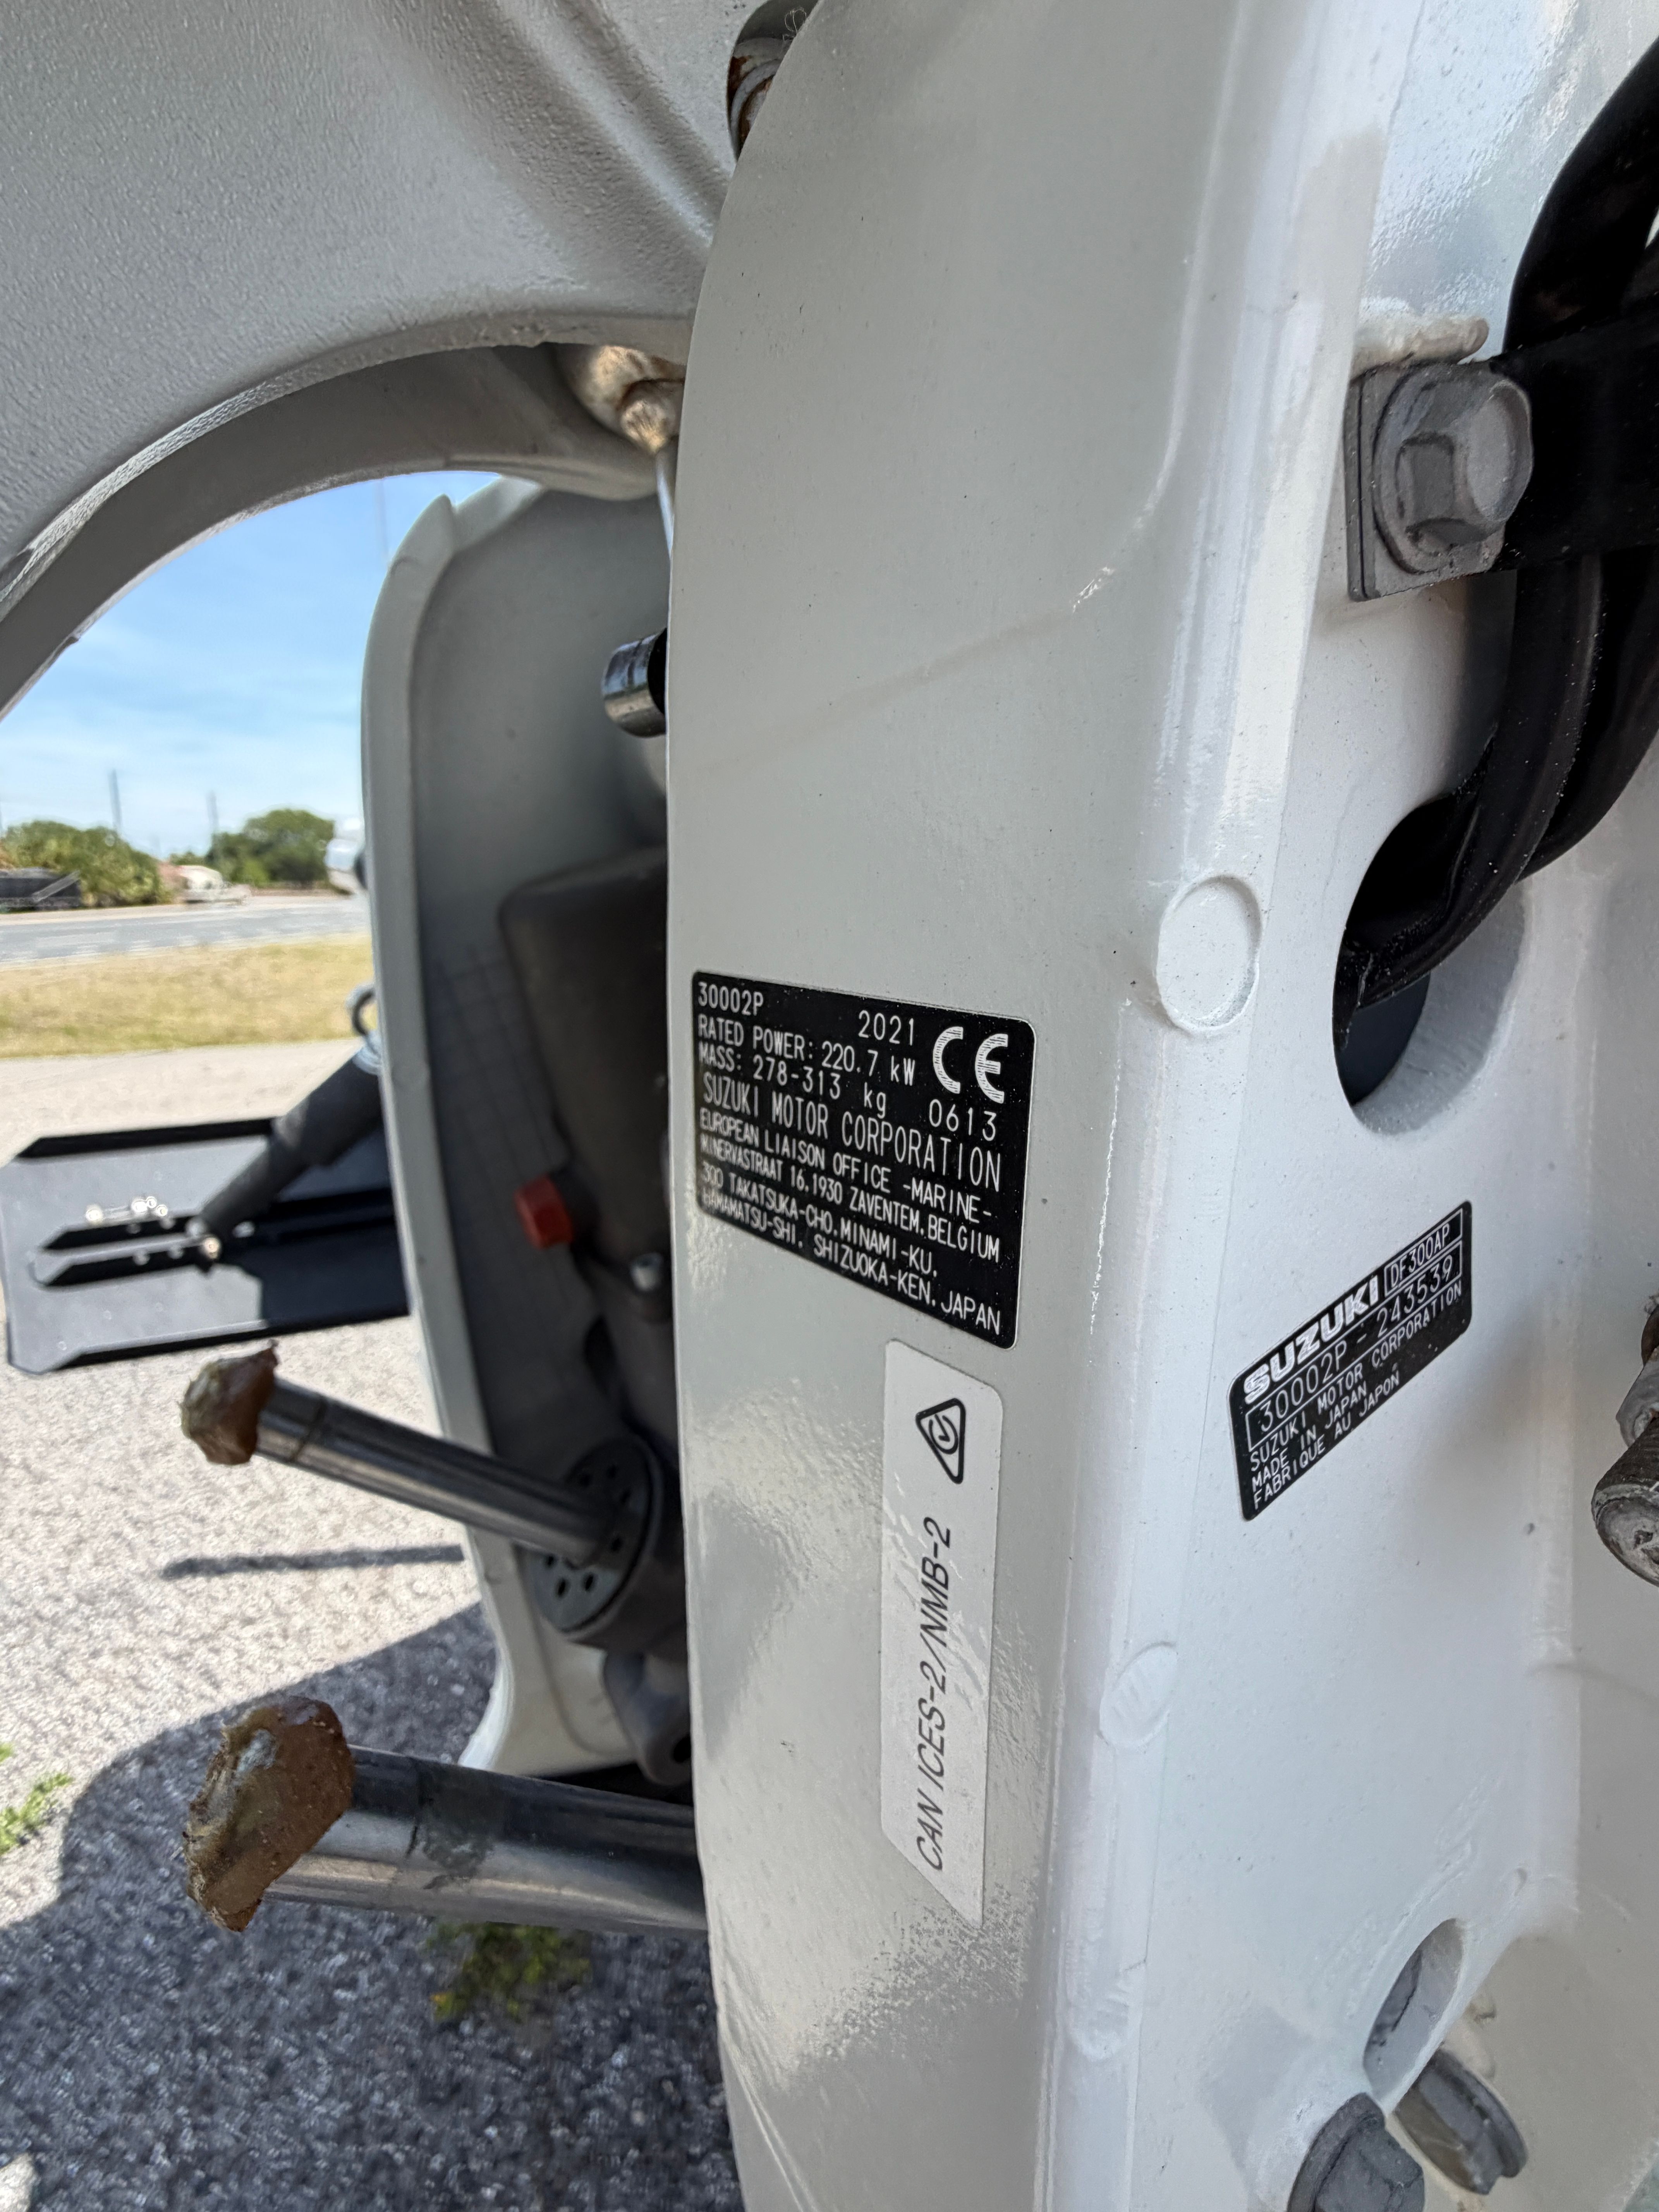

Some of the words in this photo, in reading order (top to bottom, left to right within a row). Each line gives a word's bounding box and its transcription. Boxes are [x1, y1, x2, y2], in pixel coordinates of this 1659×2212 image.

[698, 981, 763, 1016] 30002P
[859, 1010, 914, 1046] 2021
[698, 1013, 744, 1047] RATED
[753, 1025, 813, 1061] POWER:
[821, 1041, 878, 1076] 220.7
[890, 1056, 915, 1086] kW
[698, 1041, 741, 1072] MASS:
[753, 1054, 841, 1099] 278-313
[864, 1082, 886, 1119] kg
[933, 1026, 1008, 1104] CE
[700, 1133, 783, 1182] MINERVASTRAAT
[703, 1072, 759, 1118] SUZUKI
[772, 1090, 828, 1139] MOTOR
[842, 1111, 1001, 1192] CORPORATION
[929, 1099, 996, 1141] 0613
[700, 1107, 759, 1148] EUROPEAN
[764, 1129, 825, 1170] LIAISON
[833, 1152, 891, 1193] OFFICE
[903, 1177, 992, 1223] -MARINE-
[702, 1161, 724, 1190] 300
[941, 1290, 1000, 1335] JAPAN
[1244, 1275, 1379, 1405] SUZUKI
[1391, 1223, 1450, 1287] DF300AP
[1250, 1410, 1306, 1472] SUZUKI
[1318, 1362, 1363, 1415] MOTOR
[1372, 1279, 1462, 1368] CORPORATION
[1252, 1448, 1288, 1492] MADE
[1301, 1425, 1316, 1450] IN
[1325, 1380, 1367, 1429] JAPAN
[1254, 1434, 1326, 1510] FABRIQUE
[1334, 1412, 1352, 1440] AU
[1359, 1370, 1400, 1417] JAPON
[917, 1516, 950, 1791] ICES-2/NMB-2
[916, 1787, 943, 1870] CAN
